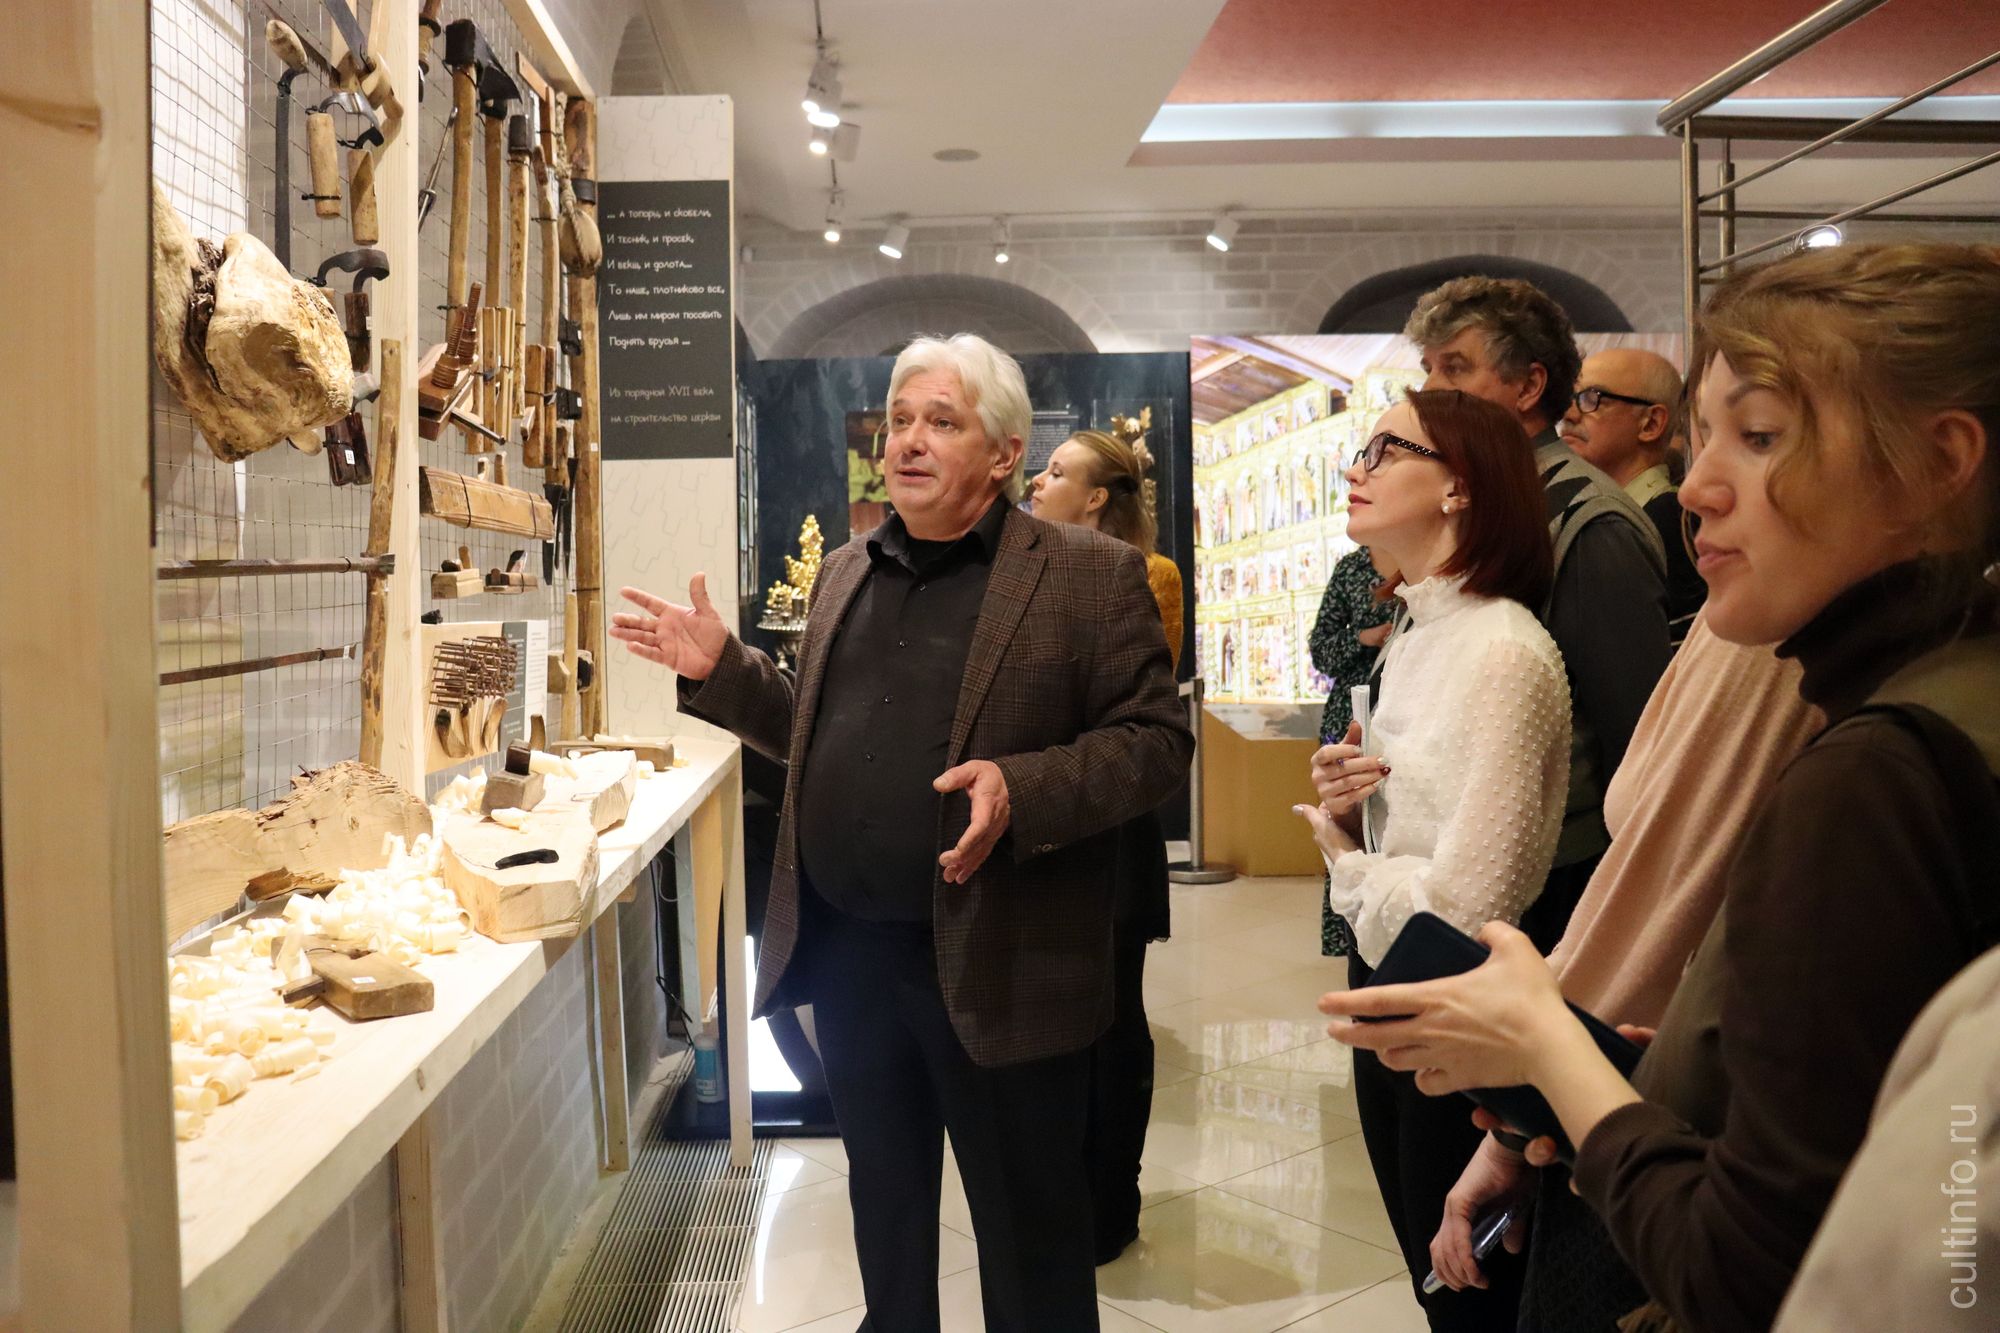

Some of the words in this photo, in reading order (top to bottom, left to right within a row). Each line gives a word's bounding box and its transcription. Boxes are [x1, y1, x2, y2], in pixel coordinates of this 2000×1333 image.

[606, 233, 616, 244] И
[606, 259, 616, 270] И
[608, 283, 623, 295] То
[608, 309, 632, 321] Лишь
[609, 336, 646, 350] Поднять
[609, 387, 622, 398] Из
[668, 385, 691, 397] XVII
